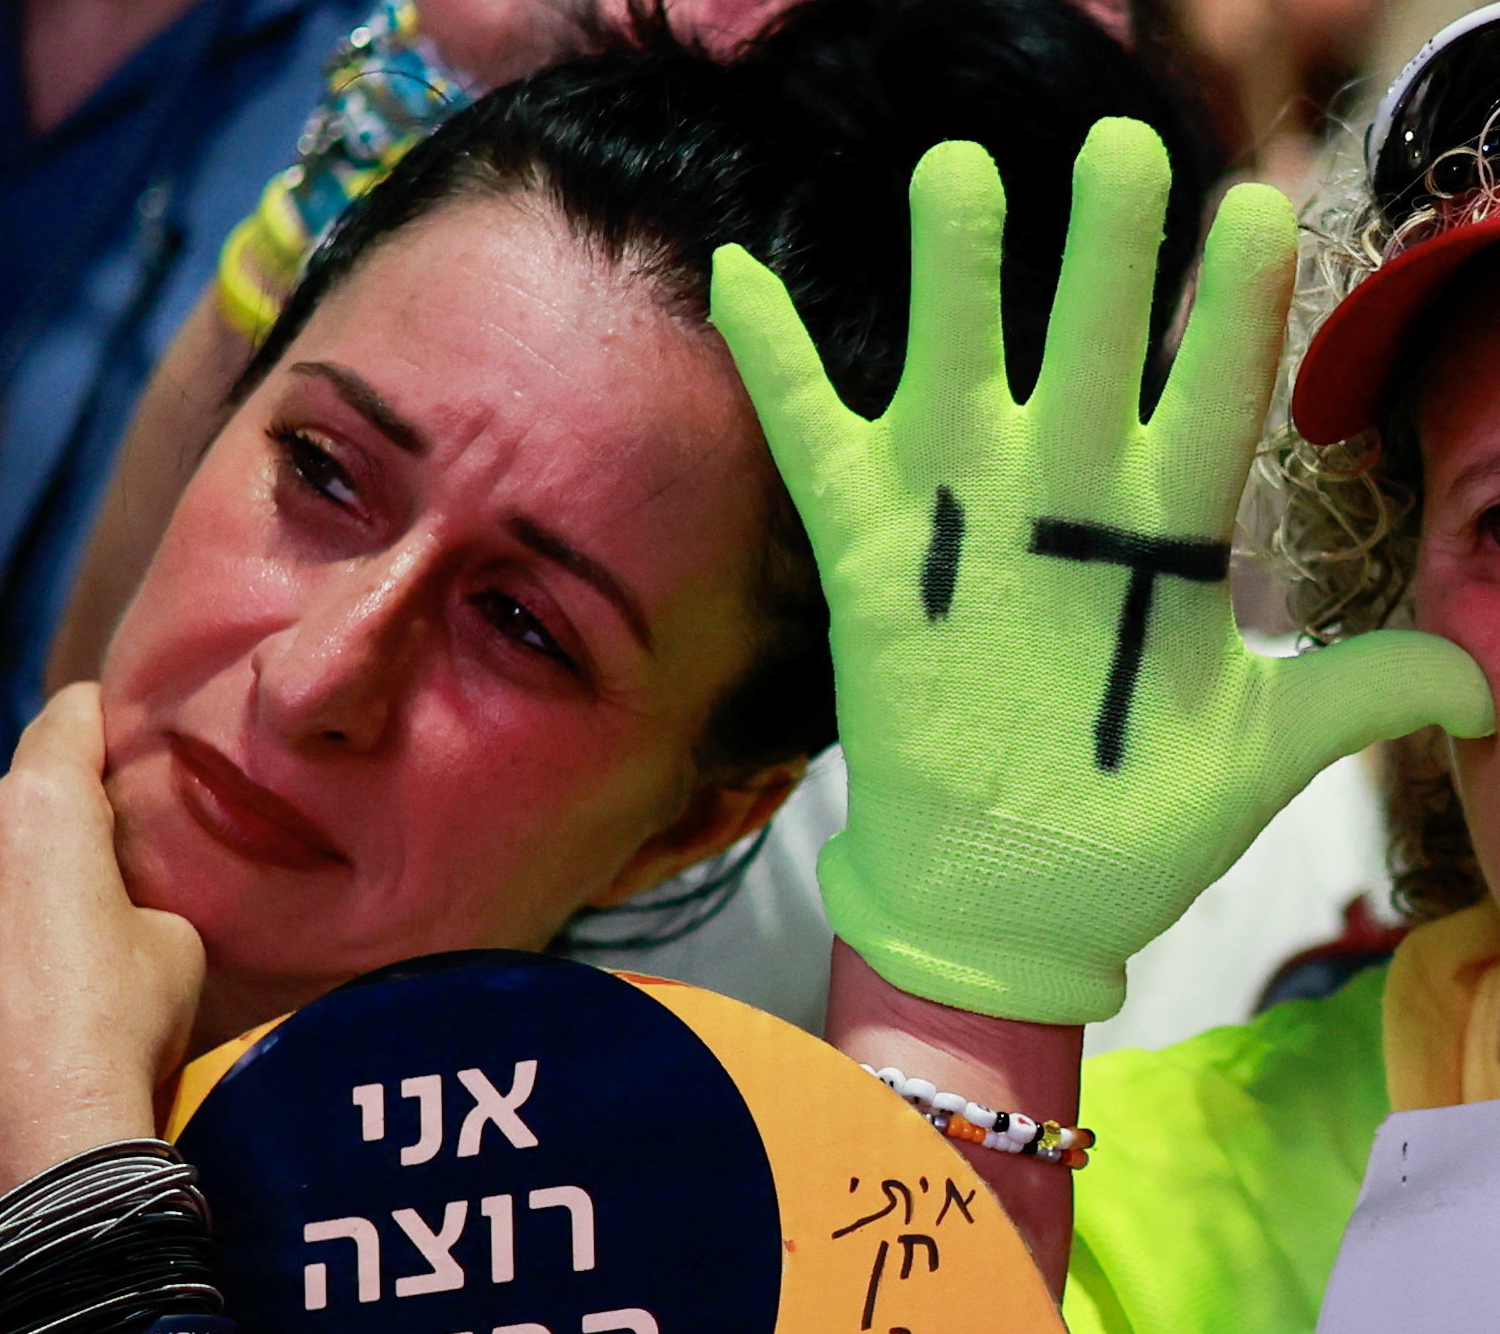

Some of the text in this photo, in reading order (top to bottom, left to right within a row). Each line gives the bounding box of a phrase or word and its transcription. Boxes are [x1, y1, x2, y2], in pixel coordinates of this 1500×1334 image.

[920, 483, 1232, 774] די
[352, 1059, 539, 1167] אני
[303, 1184, 596, 1312] רוצה
[860, 1233, 939, 1331] חן
